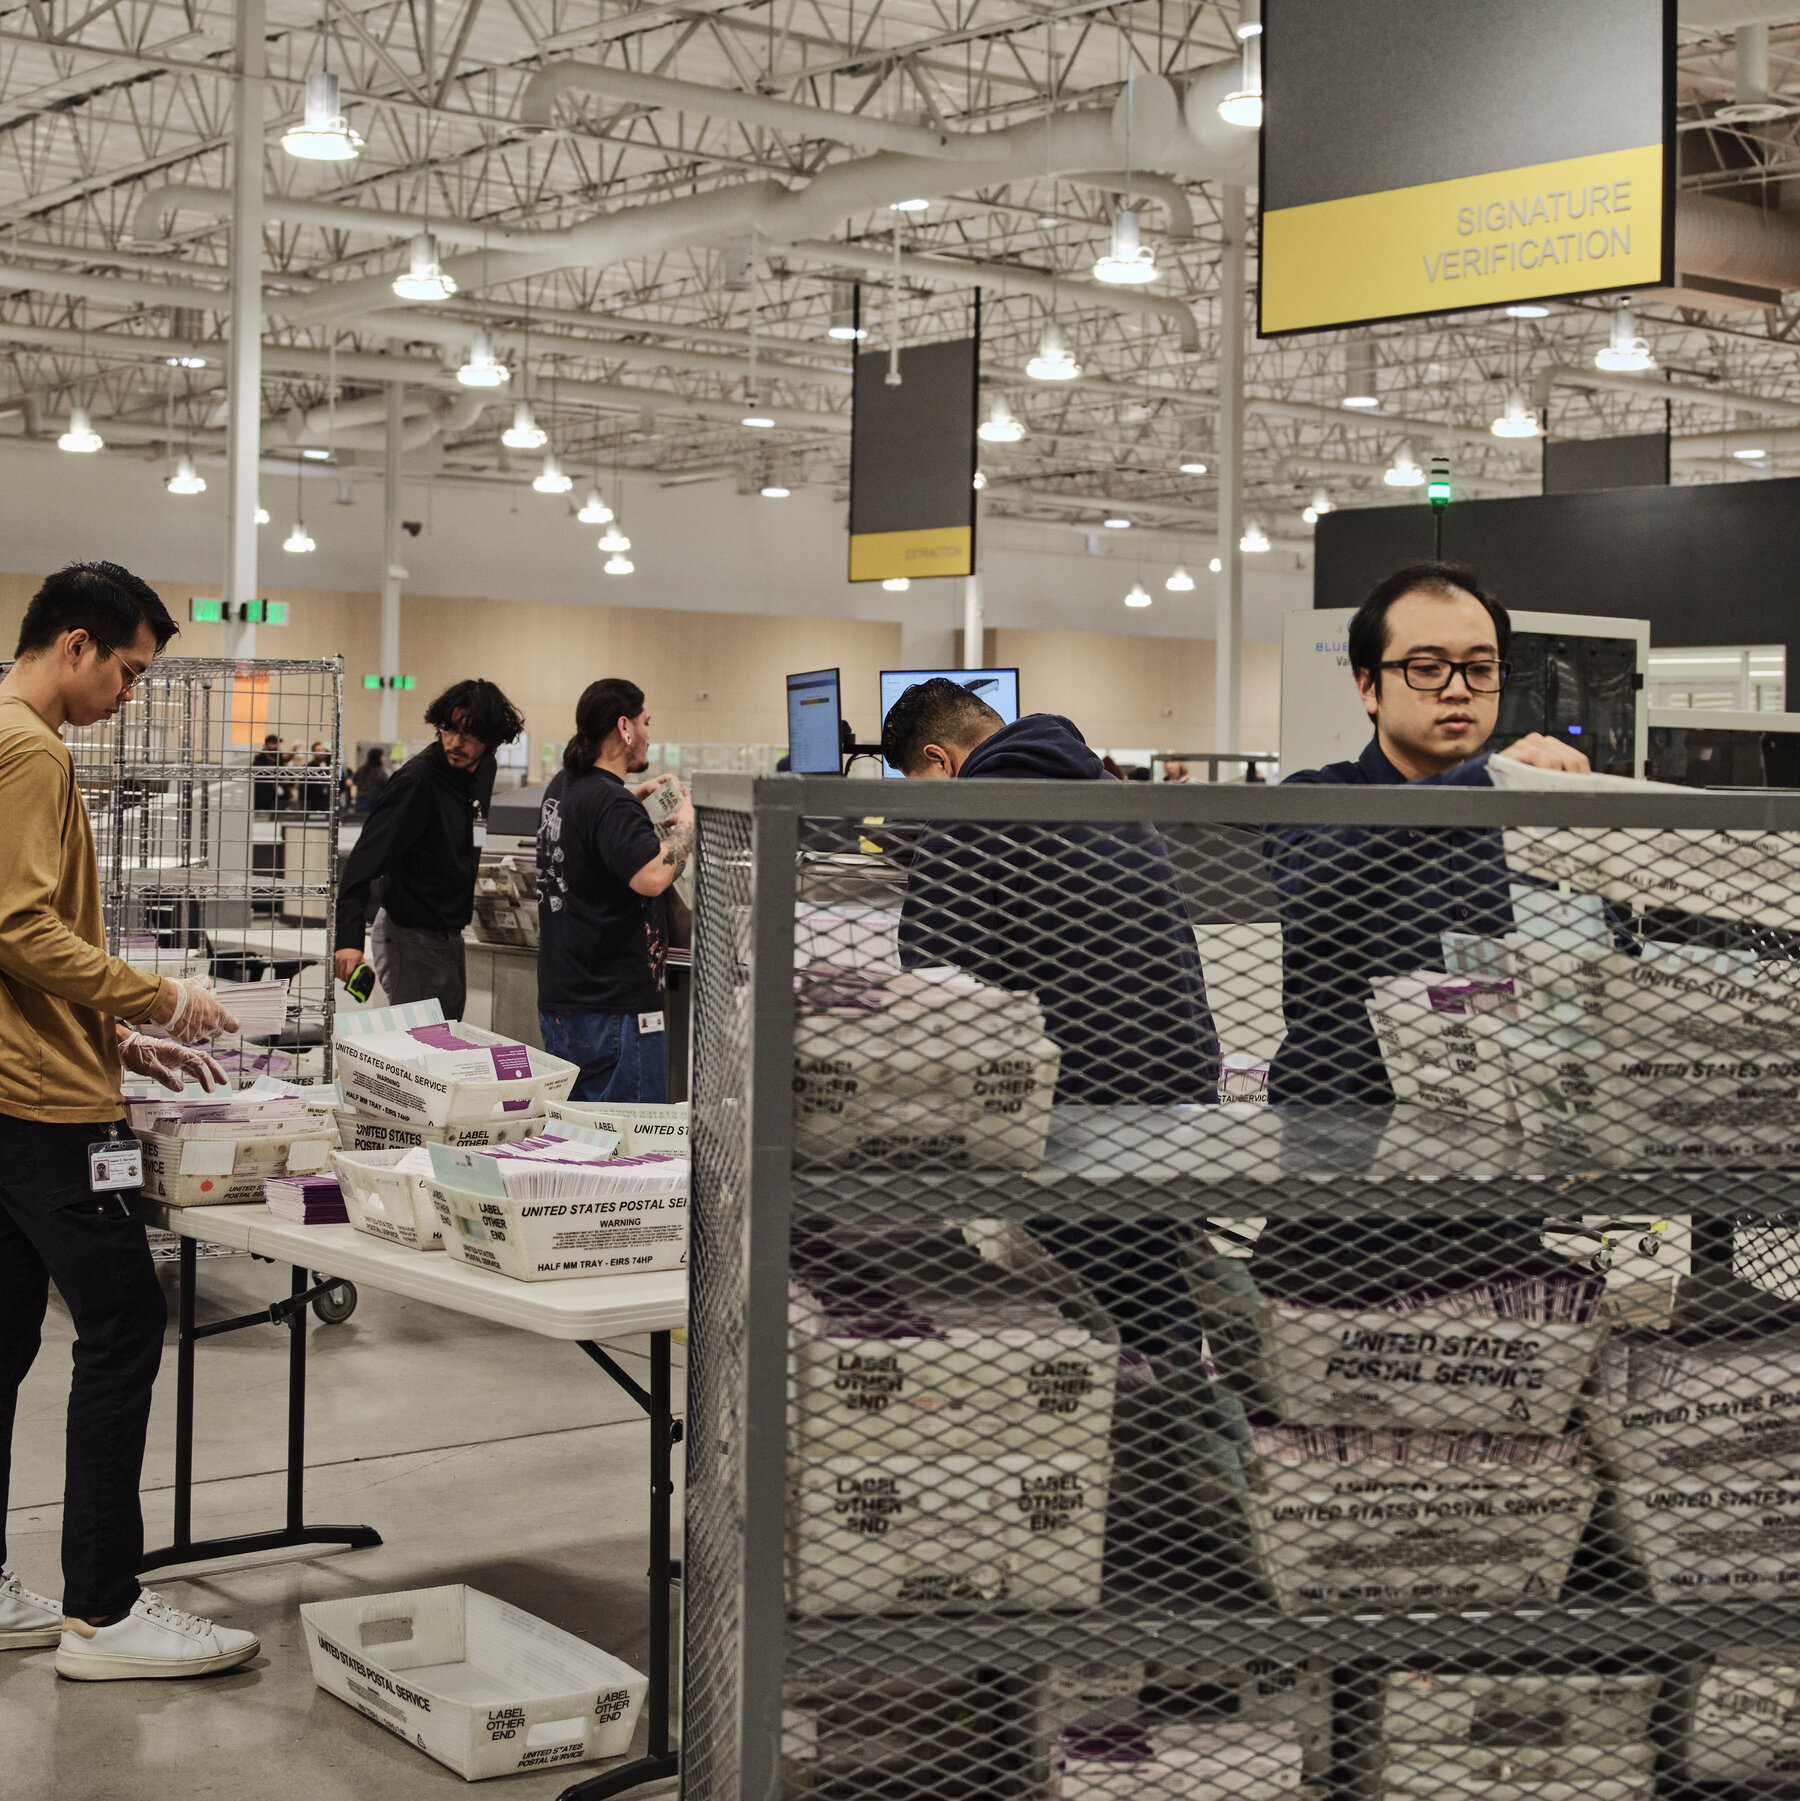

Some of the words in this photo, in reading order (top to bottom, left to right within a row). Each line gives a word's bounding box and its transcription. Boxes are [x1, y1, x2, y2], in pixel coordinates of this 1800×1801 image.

[1457, 180, 1631, 235] SIGNATURE
[1423, 224, 1631, 282] VERIFICATION
[335, 1042, 358, 1058] UNITED
[359, 1052, 384, 1070] STATES
[385, 1063, 413, 1082] POSTAL
[414, 1075, 448, 1093] SERVICE
[376, 1073, 400, 1088] WARNING
[346, 1090, 359, 1101] HALF
[368, 1099, 382, 1111] TRAY
[385, 1106, 397, 1118] EIRS
[459, 1130, 489, 1139] LABEL
[594, 1121, 617, 1133] LABEL
[634, 1124, 675, 1135] UNITED
[356, 1124, 387, 1140] UNITED
[388, 1129, 422, 1146] STATES
[456, 1139, 489, 1147] OTHER
[479, 1203, 503, 1216] LABEL
[521, 1206, 567, 1217] UNITED
[570, 1202, 616, 1215] STATES
[619, 1199, 665, 1212] POSTAL
[482, 1216, 507, 1229] OTHER
[600, 1218, 641, 1228] WARNING
[490, 1230, 506, 1241] END
[464, 1252, 482, 1263] POSTAL
[482, 1257, 501, 1269] SERVICE
[538, 1262, 561, 1271] HALF
[563, 1261, 578, 1270] MM
[580, 1259, 603, 1268] TRAY
[610, 1257, 630, 1266] EIRS
[632, 1256, 653, 1265] 74HP
[1342, 1330, 1437, 1354] UNITED
[1441, 1336, 1540, 1361] STATES
[1326, 1357, 1423, 1382] POSTAL
[1434, 1363, 1545, 1389] SERVICE
[318, 1635, 340, 1660] UNITED
[340, 1651, 366, 1677] STATES
[367, 1667, 396, 1695] POSTAL
[396, 1685, 431, 1713] SERVICE
[597, 1689, 630, 1705] LABEL
[488, 1707, 525, 1720] LABEL
[594, 1699, 630, 1715] OTHER
[486, 1718, 525, 1731] OTHER
[599, 1711, 622, 1724] END
[491, 1729, 516, 1741] END
[517, 1756, 549, 1768] POSTAL
[550, 1750, 585, 1762] SERVICE
[522, 1749, 552, 1760] UNITED
